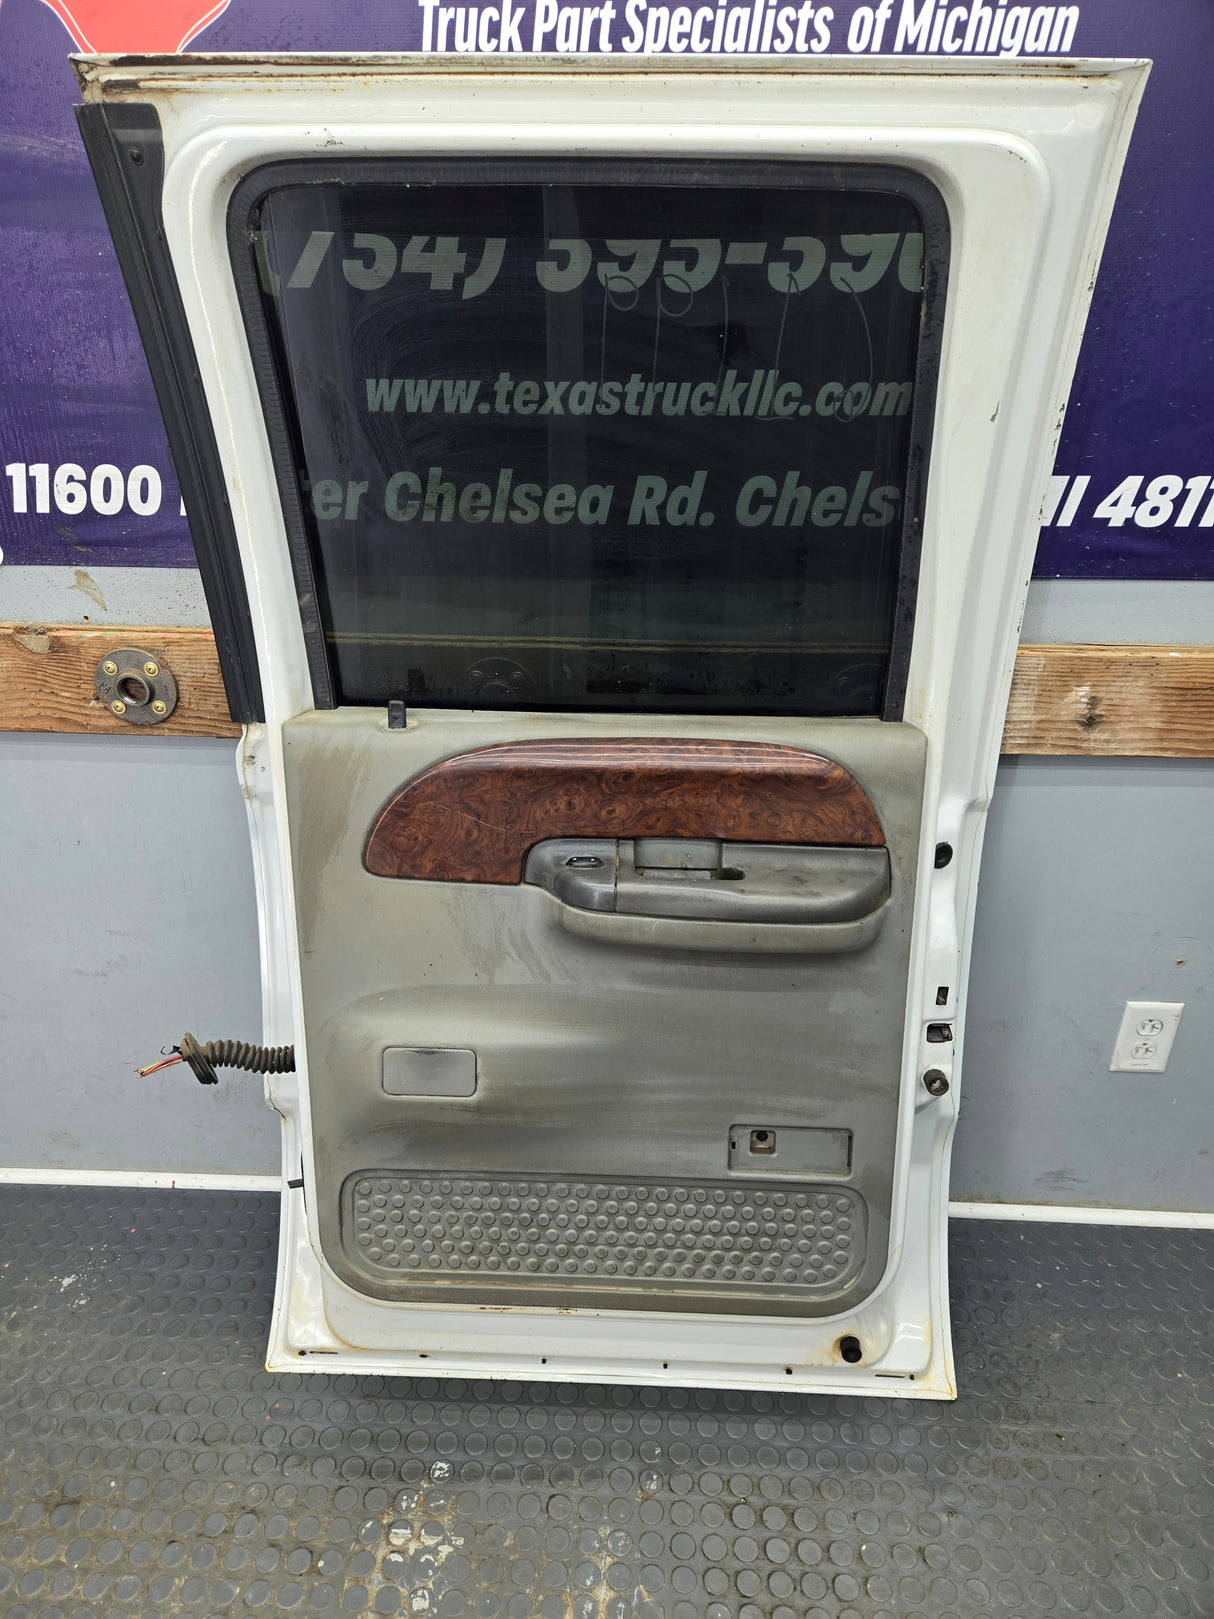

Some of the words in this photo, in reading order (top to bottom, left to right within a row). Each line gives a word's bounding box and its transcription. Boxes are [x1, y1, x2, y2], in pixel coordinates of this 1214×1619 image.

[418, 0, 526, 52] Truck
[532, 0, 617, 52] Part
[621, 0, 835, 54] Specialists
[847, 0, 895, 53] of
[893, 0, 1080, 57] Michigan
[366, 370, 912, 417] www.texastruckllc.com
[5, 463, 163, 517] 11600
[384, 467, 616, 526] Chelsea
[628, 471, 715, 527] Rd.
[735, 471, 901, 528] Chels
